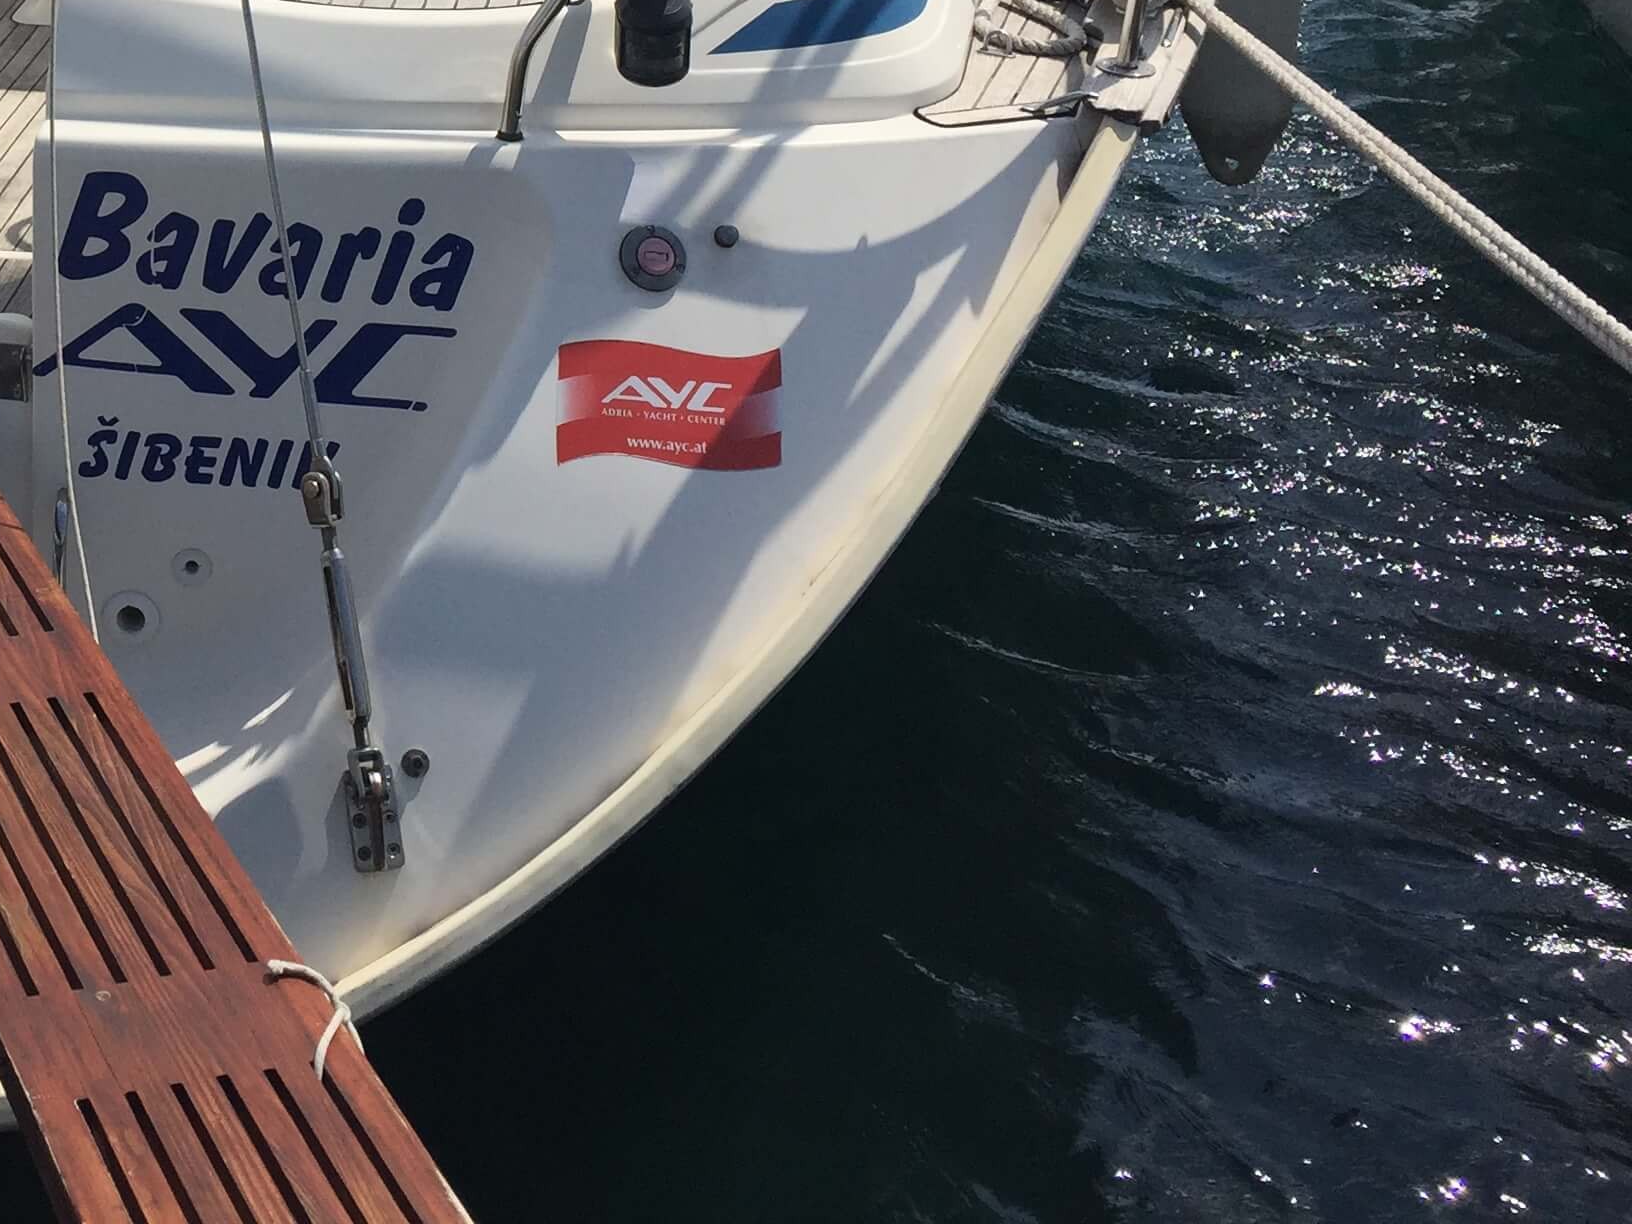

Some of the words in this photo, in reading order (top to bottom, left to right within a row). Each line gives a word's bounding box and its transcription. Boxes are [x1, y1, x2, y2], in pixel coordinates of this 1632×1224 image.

[58, 170, 475, 312] Bavaria
[32, 302, 458, 411] AYC
[601, 375, 733, 413] AYC
[601, 407, 633, 418] ADRIA
[642, 410, 677, 423] YACHT
[687, 415, 726, 427] CENTER
[627, 437, 708, 455] www.ayc.at
